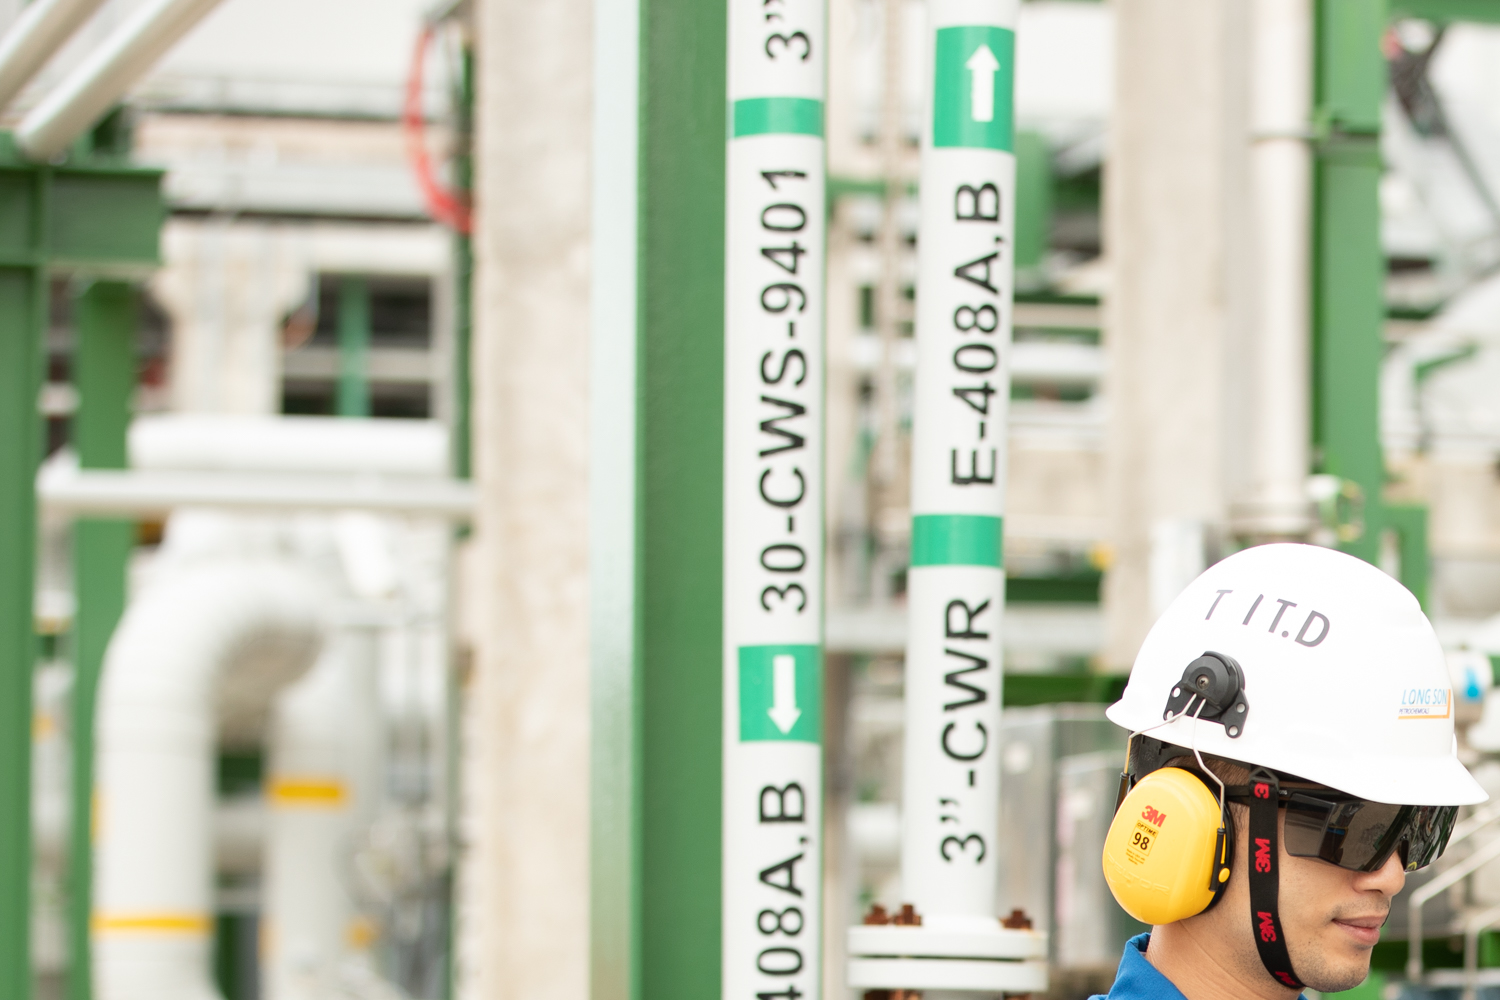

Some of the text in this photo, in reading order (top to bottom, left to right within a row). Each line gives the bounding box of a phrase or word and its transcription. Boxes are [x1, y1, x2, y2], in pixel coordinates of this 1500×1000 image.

[951, 181, 1008, 486] E-408A,B
[759, 169, 808, 613] 30-CWS-9401
[1401, 688, 1447, 705] LONG SON
[1398, 707, 1430, 715] PETROCHEMICALS
[1141, 805, 1167, 828] 3M
[1136, 822, 1157, 836] OPTIME
[1132, 832, 1150, 851] 98
[1255, 837, 1271, 874] 3M
[1257, 911, 1277, 943] 3M
